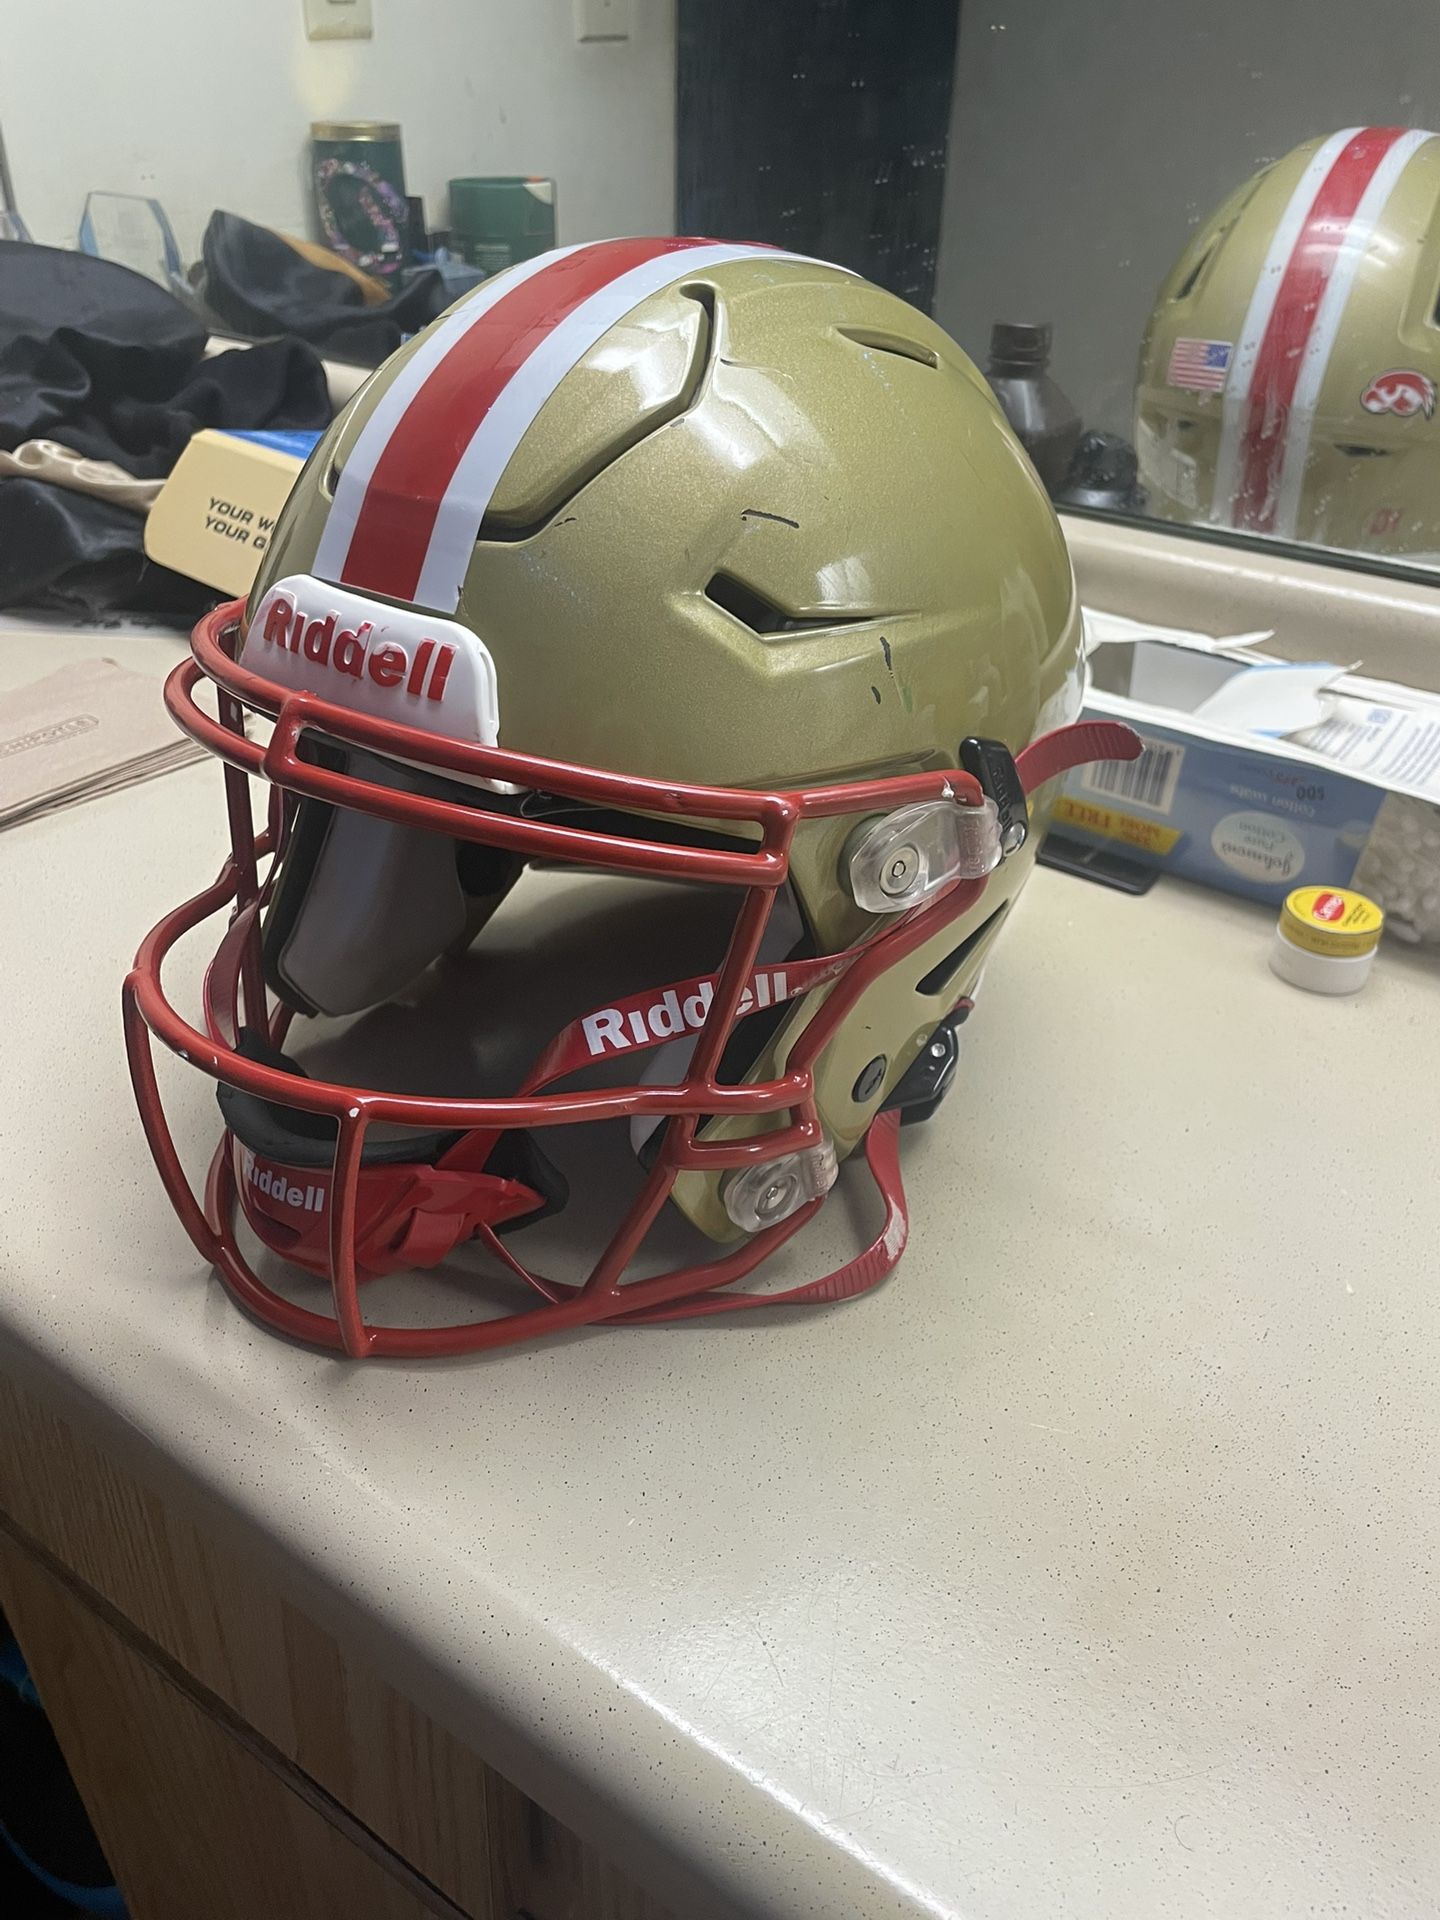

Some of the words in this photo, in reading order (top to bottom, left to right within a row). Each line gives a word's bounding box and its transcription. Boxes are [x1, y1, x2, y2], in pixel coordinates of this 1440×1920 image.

[205, 515, 250, 544] YOUR
[209, 496, 254, 525] YOUR
[258, 516, 275, 532] W
[263, 590, 459, 701] Riddell
[243, 1152, 325, 1213] Riddell
